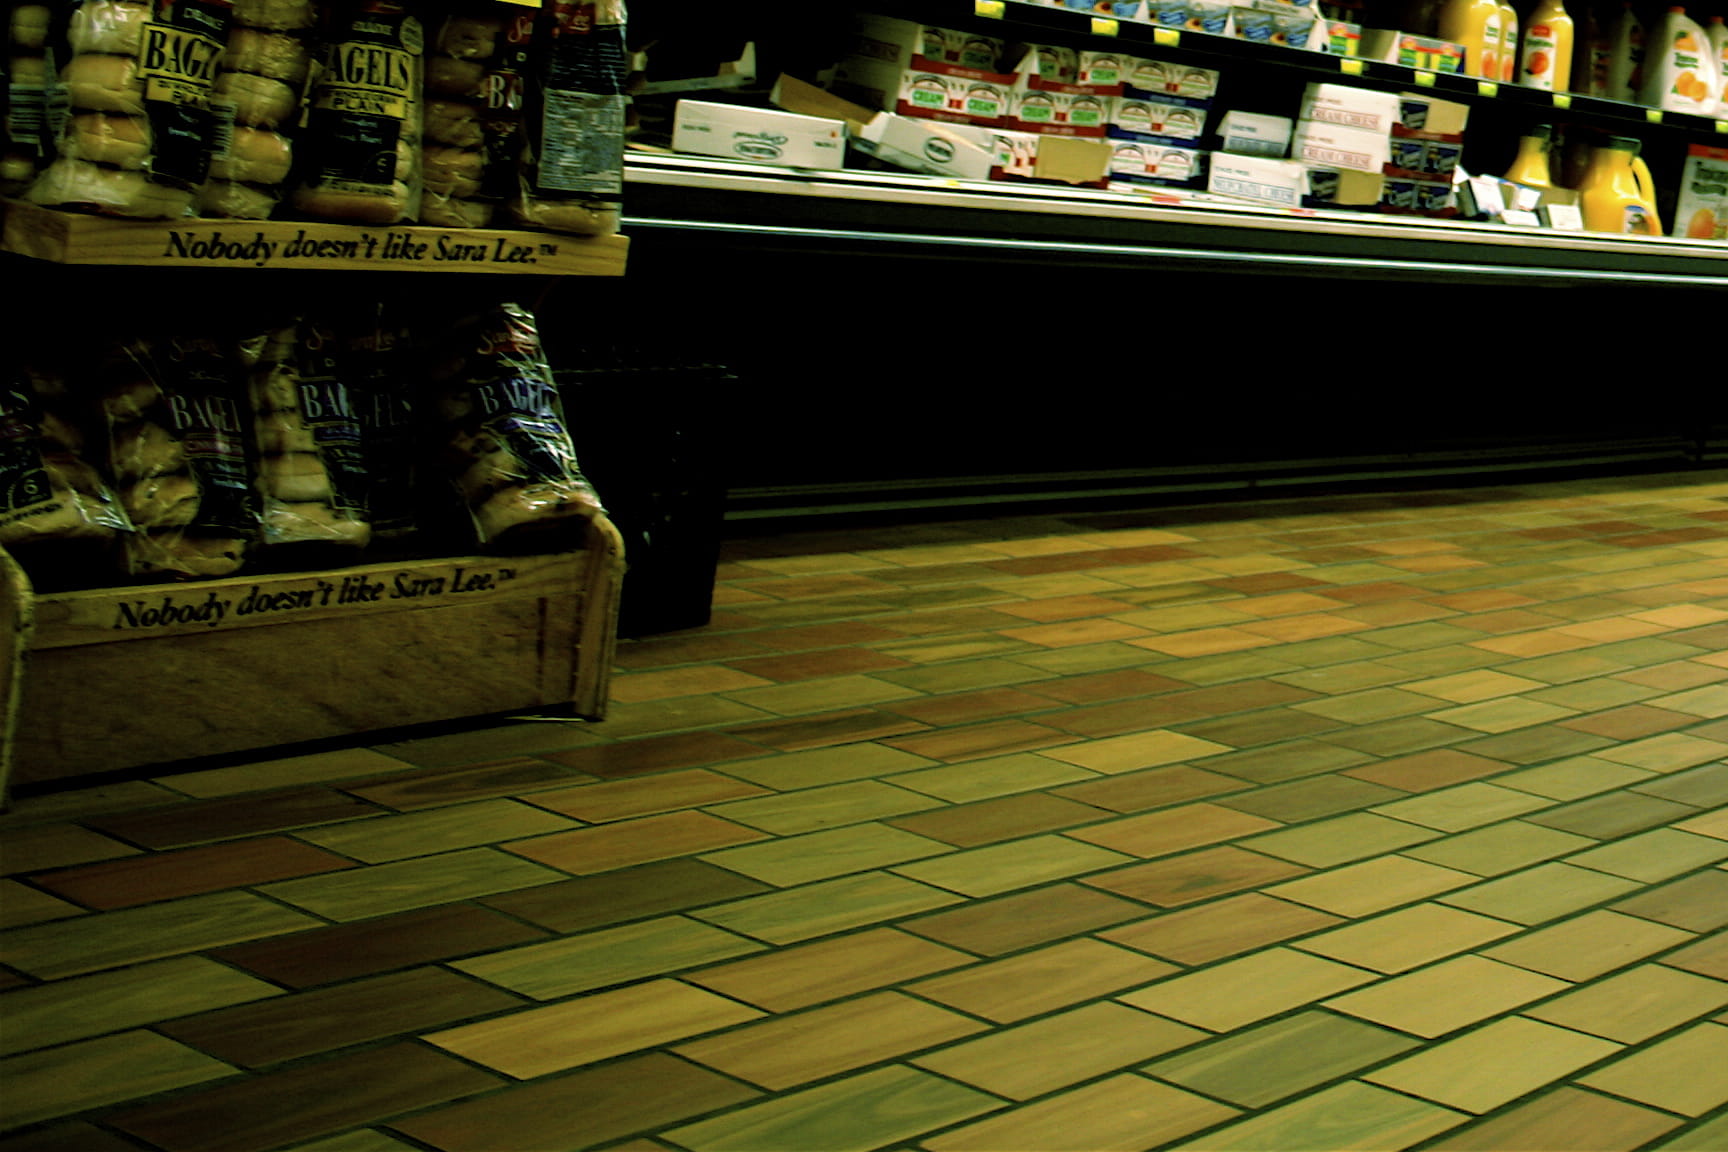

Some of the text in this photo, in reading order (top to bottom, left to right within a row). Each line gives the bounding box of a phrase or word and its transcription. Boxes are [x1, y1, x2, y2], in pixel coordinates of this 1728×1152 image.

[163, 230, 277, 266] Nobody
[282, 230, 378, 260] doesn't
[380, 232, 427, 261] like
[432, 234, 486, 262] Sara
[23, 478, 40, 496] 6
[113, 592, 232, 631] Nobody
[236, 579, 334, 617] doesn't
[338, 576, 386, 605] like
[389, 572, 446, 600] Sara
